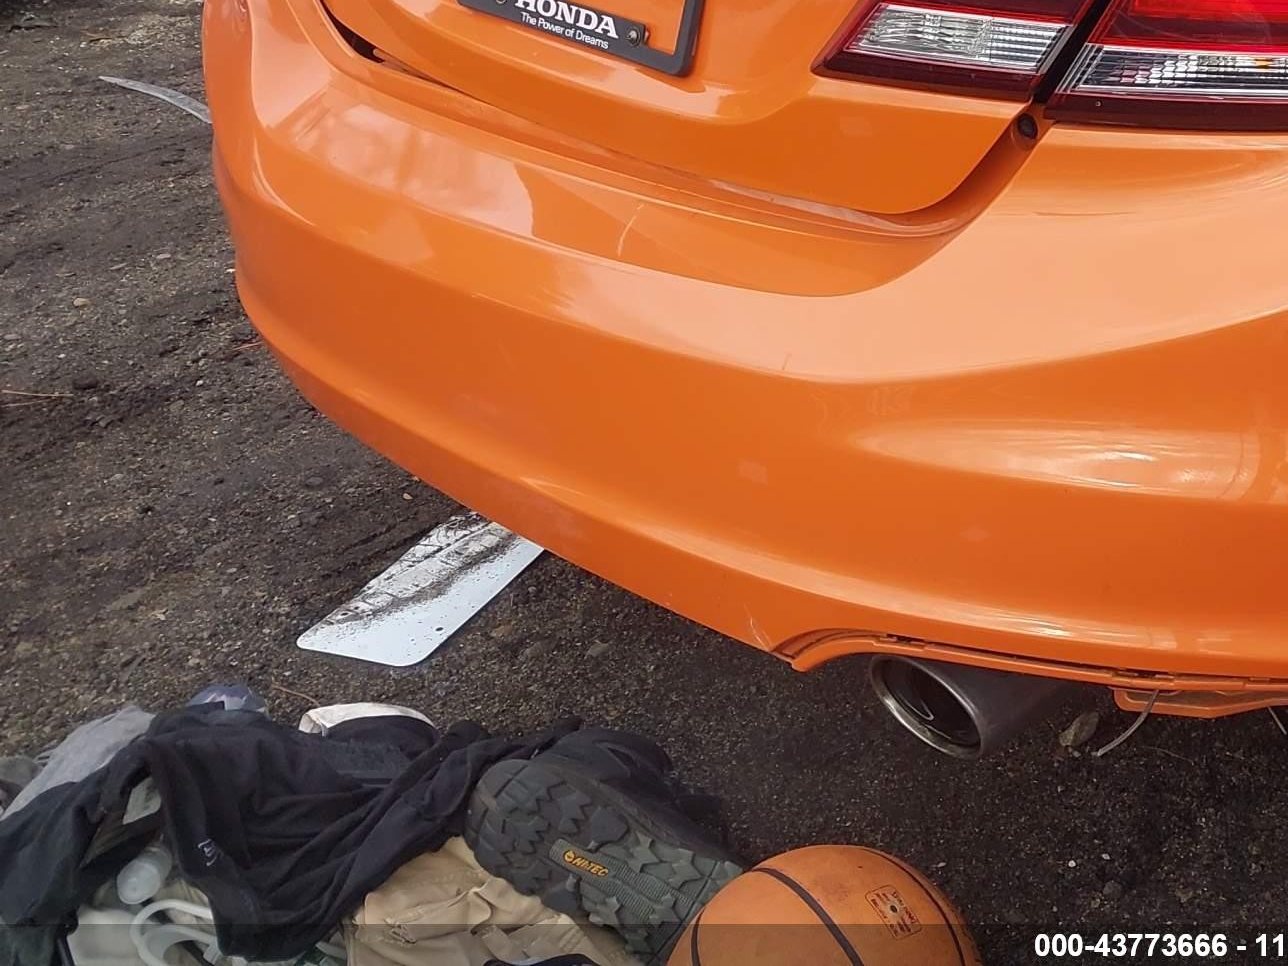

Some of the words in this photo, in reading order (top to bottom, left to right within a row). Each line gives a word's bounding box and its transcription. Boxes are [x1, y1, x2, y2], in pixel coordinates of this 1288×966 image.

[520, 11, 537, 26] The
[537, 17, 565, 36] Power
[564, 28, 575, 38] of
[575, 30, 609, 50] Dreams
